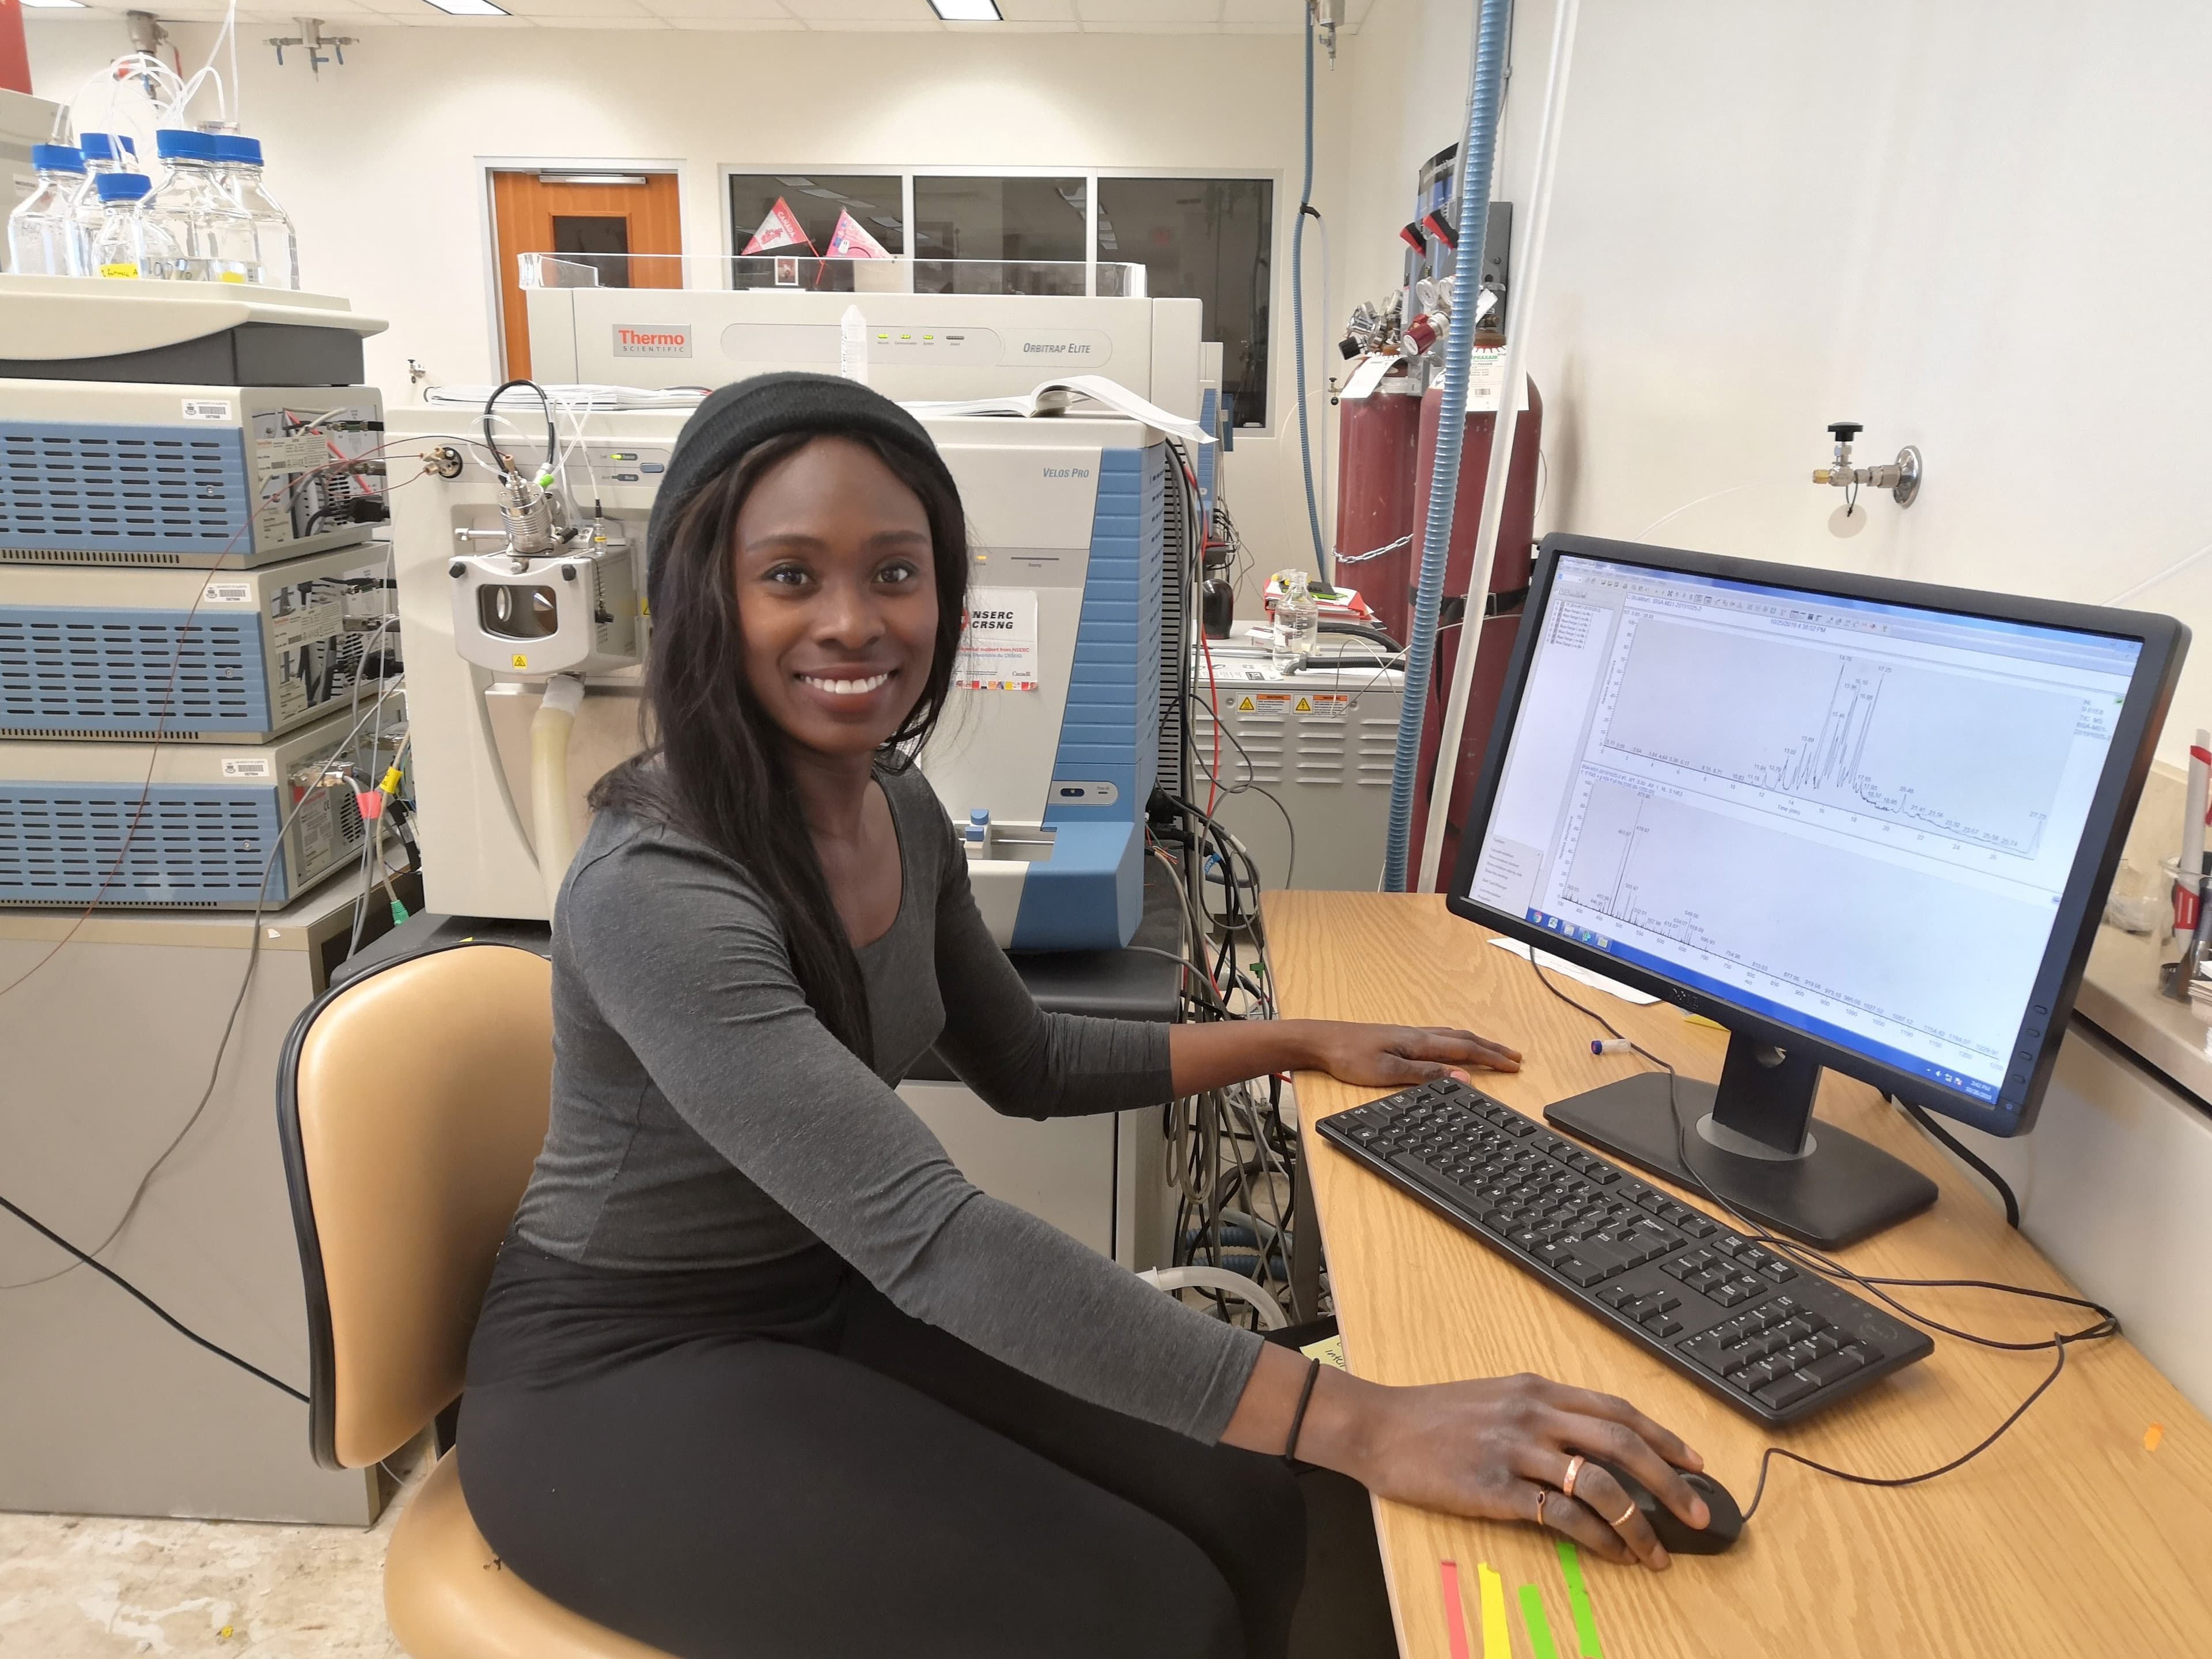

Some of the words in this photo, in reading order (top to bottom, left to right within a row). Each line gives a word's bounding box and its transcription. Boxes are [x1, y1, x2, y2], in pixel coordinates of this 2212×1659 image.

[778, 211, 796, 238] CANADA
[618, 329, 685, 345] Thermo
[1023, 342, 1066, 353] ORBITRAP
[1067, 343, 1092, 354] ELITE
[1043, 467, 1070, 478] VELOS
[1071, 468, 1090, 478] PRO
[972, 611, 1014, 620] NSERC
[972, 621, 1014, 630] CRSNG
